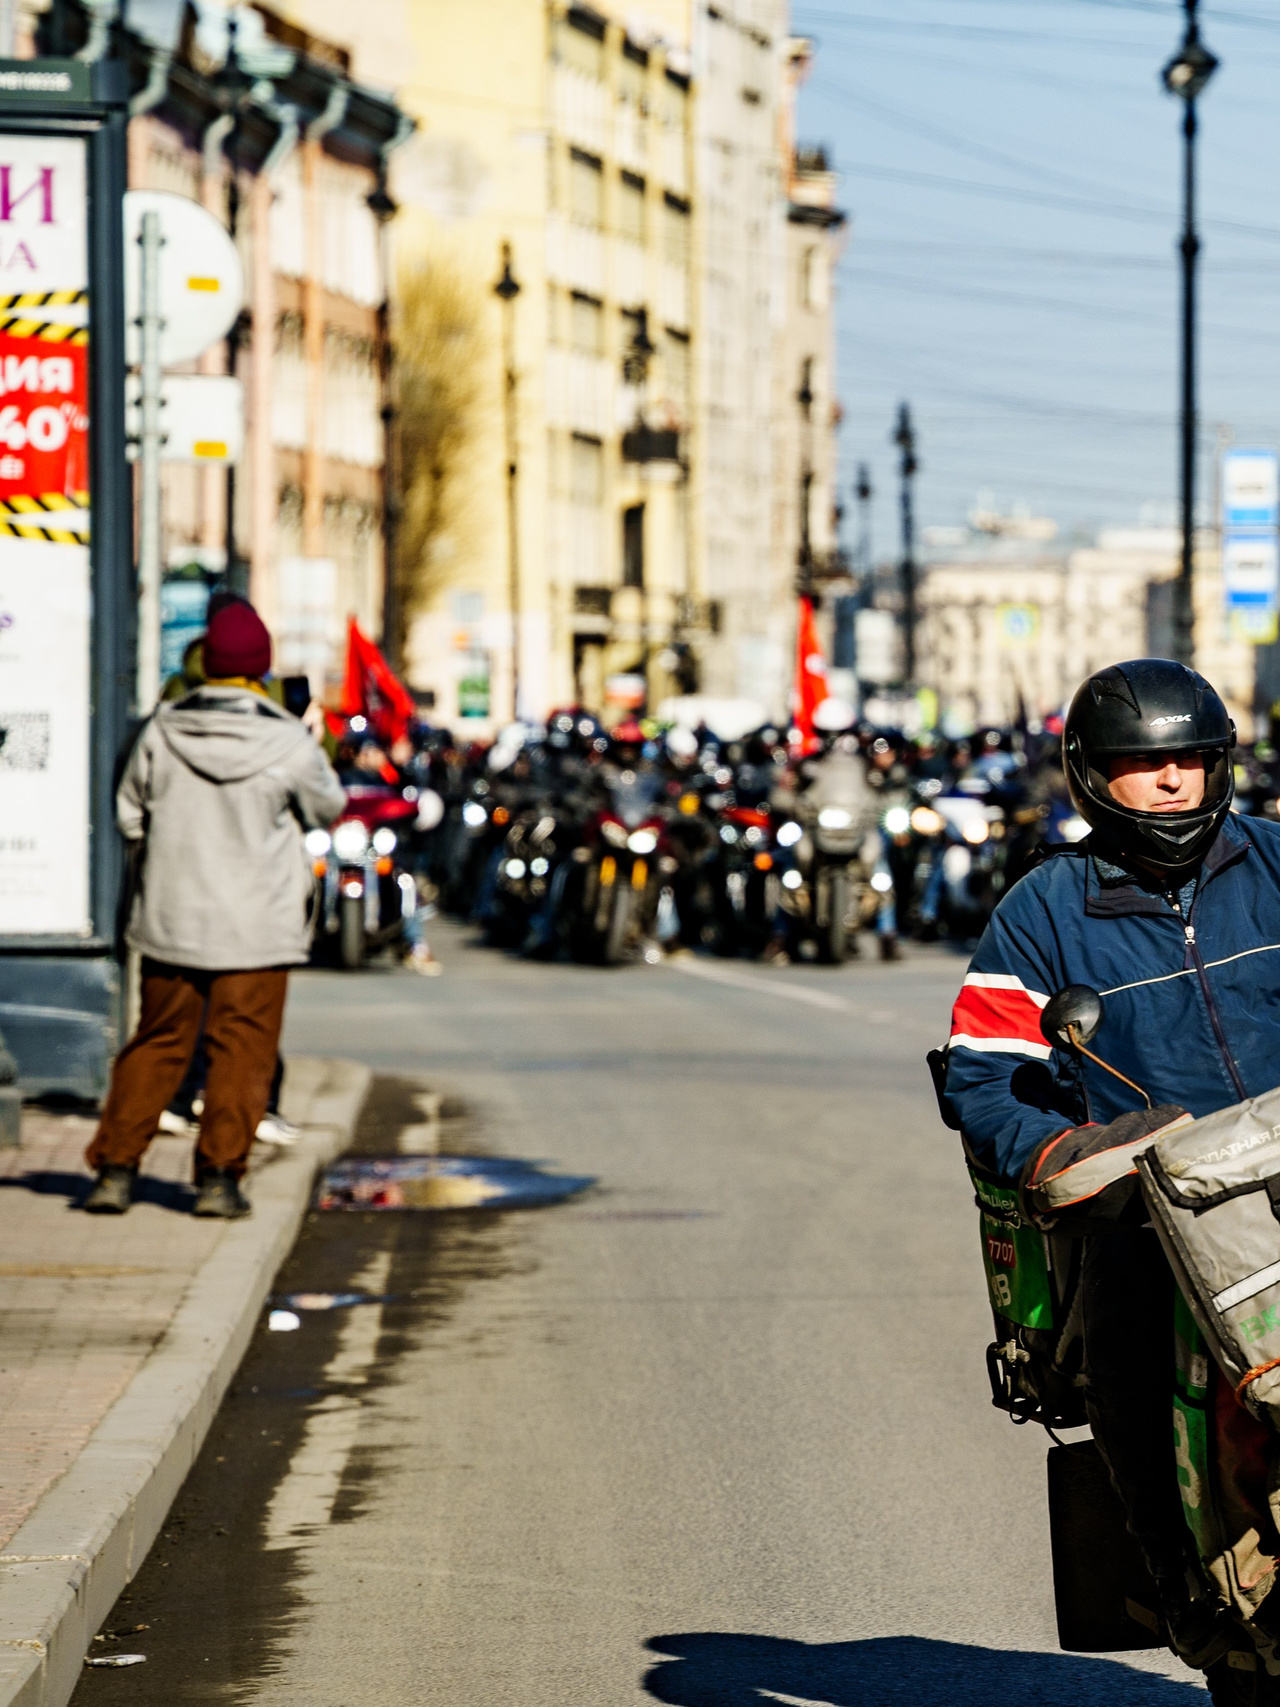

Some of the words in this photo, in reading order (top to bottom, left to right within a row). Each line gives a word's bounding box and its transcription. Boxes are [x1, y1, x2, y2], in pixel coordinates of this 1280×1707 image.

[0, 241, 37, 271] А
[1168, 1132, 1271, 1176] БЕСПЛАТНАЯ
[988, 1240, 1013, 1262] 7707
